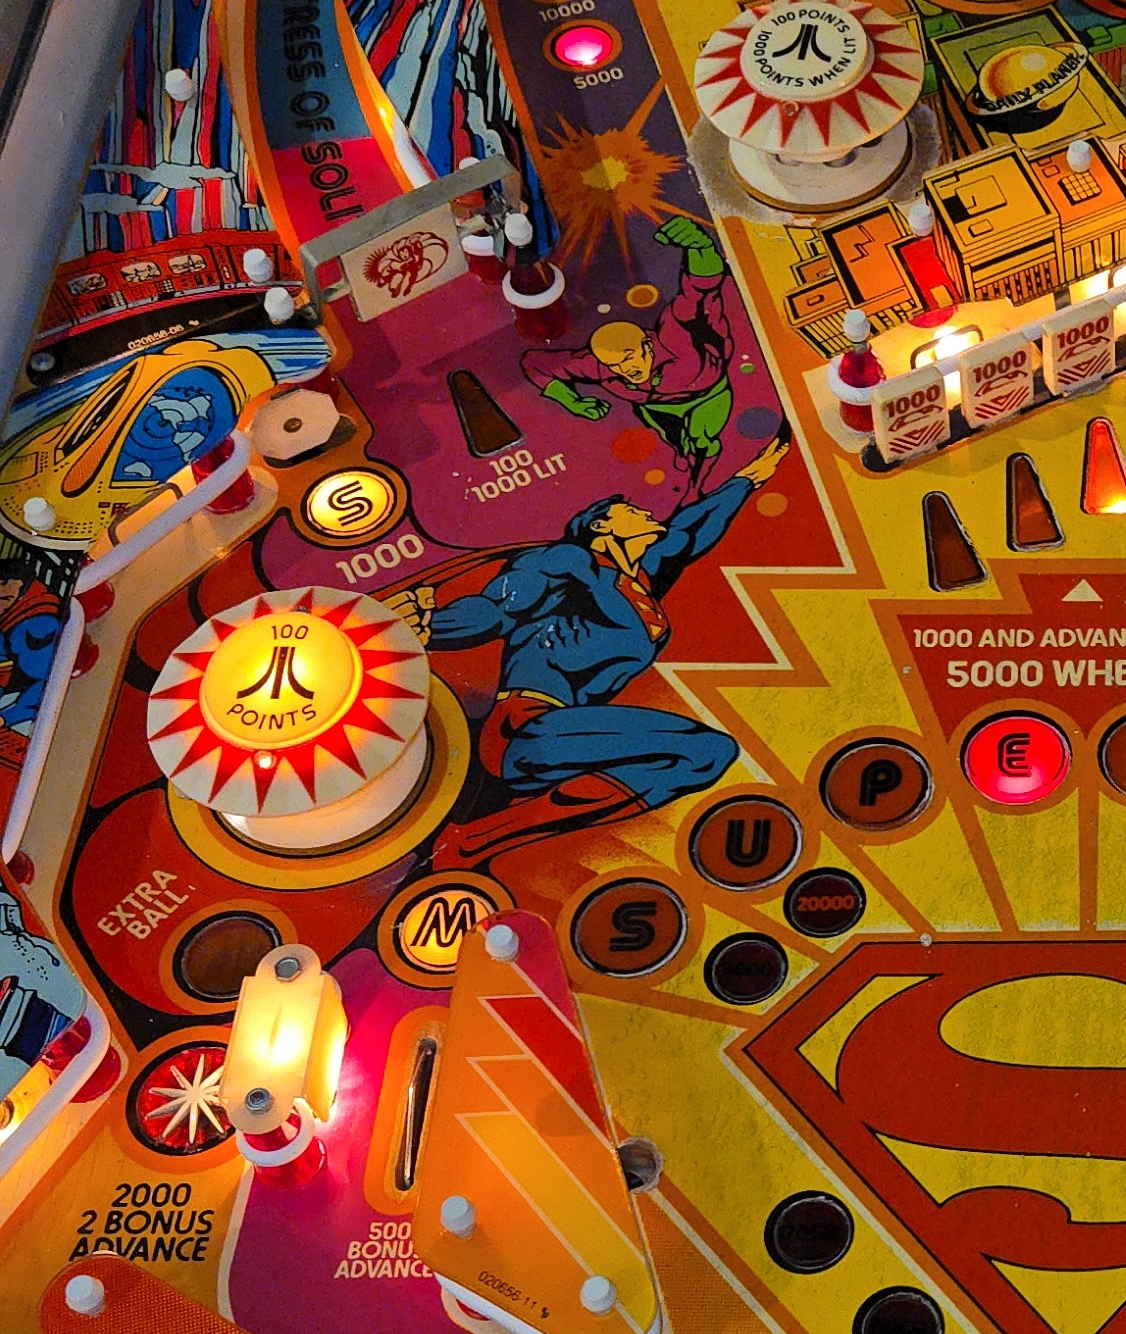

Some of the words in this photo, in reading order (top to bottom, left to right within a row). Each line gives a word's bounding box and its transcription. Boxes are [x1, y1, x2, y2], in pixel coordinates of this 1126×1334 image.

[539, 0, 597, 23] 10000
[771, 11, 796, 27] 100
[799, 9, 850, 34] POINTS
[753, 30, 773, 57] 1000
[843, 37, 856, 55] LIT
[573, 68, 625, 91] 5000
[755, 58, 804, 87] POINTS
[808, 56, 852, 87] WHEN
[289, 90, 337, 133] OF
[984, 86, 1033, 111] DAILY
[1057, 315, 1110, 349] 1000
[973, 350, 1027, 384] 1000
[886, 384, 942, 419] 1000
[489, 449, 533, 476] 100
[471, 469, 532, 502] 1000
[532, 453, 566, 479] LIT
[327, 480, 374, 526] S
[336, 533, 425, 584] 1000
[271, 624, 309, 641] 100
[913, 628, 974, 649] 1000
[978, 628, 1035, 648] AND
[947, 659, 1044, 688] 5000
[226, 703, 319, 733] POINTS
[997, 732, 1032, 777] E
[858, 759, 902, 807] P
[725, 819, 771, 867] U
[97, 870, 178, 936] EXTRA
[126, 890, 190, 940] BALL
[796, 893, 855, 912] 20000
[411, 898, 474, 949] M
[609, 901, 657, 952] S
[111, 1182, 192, 1208] 2000
[77, 1210, 98, 1234] 2
[104, 1209, 215, 1235] BONUS
[368, 1221, 412, 1240] 500
[69, 1237, 210, 1262] ADVANCE
[347, 1240, 420, 1259] BONU
[333, 1259, 433, 1279] ADVANCE
